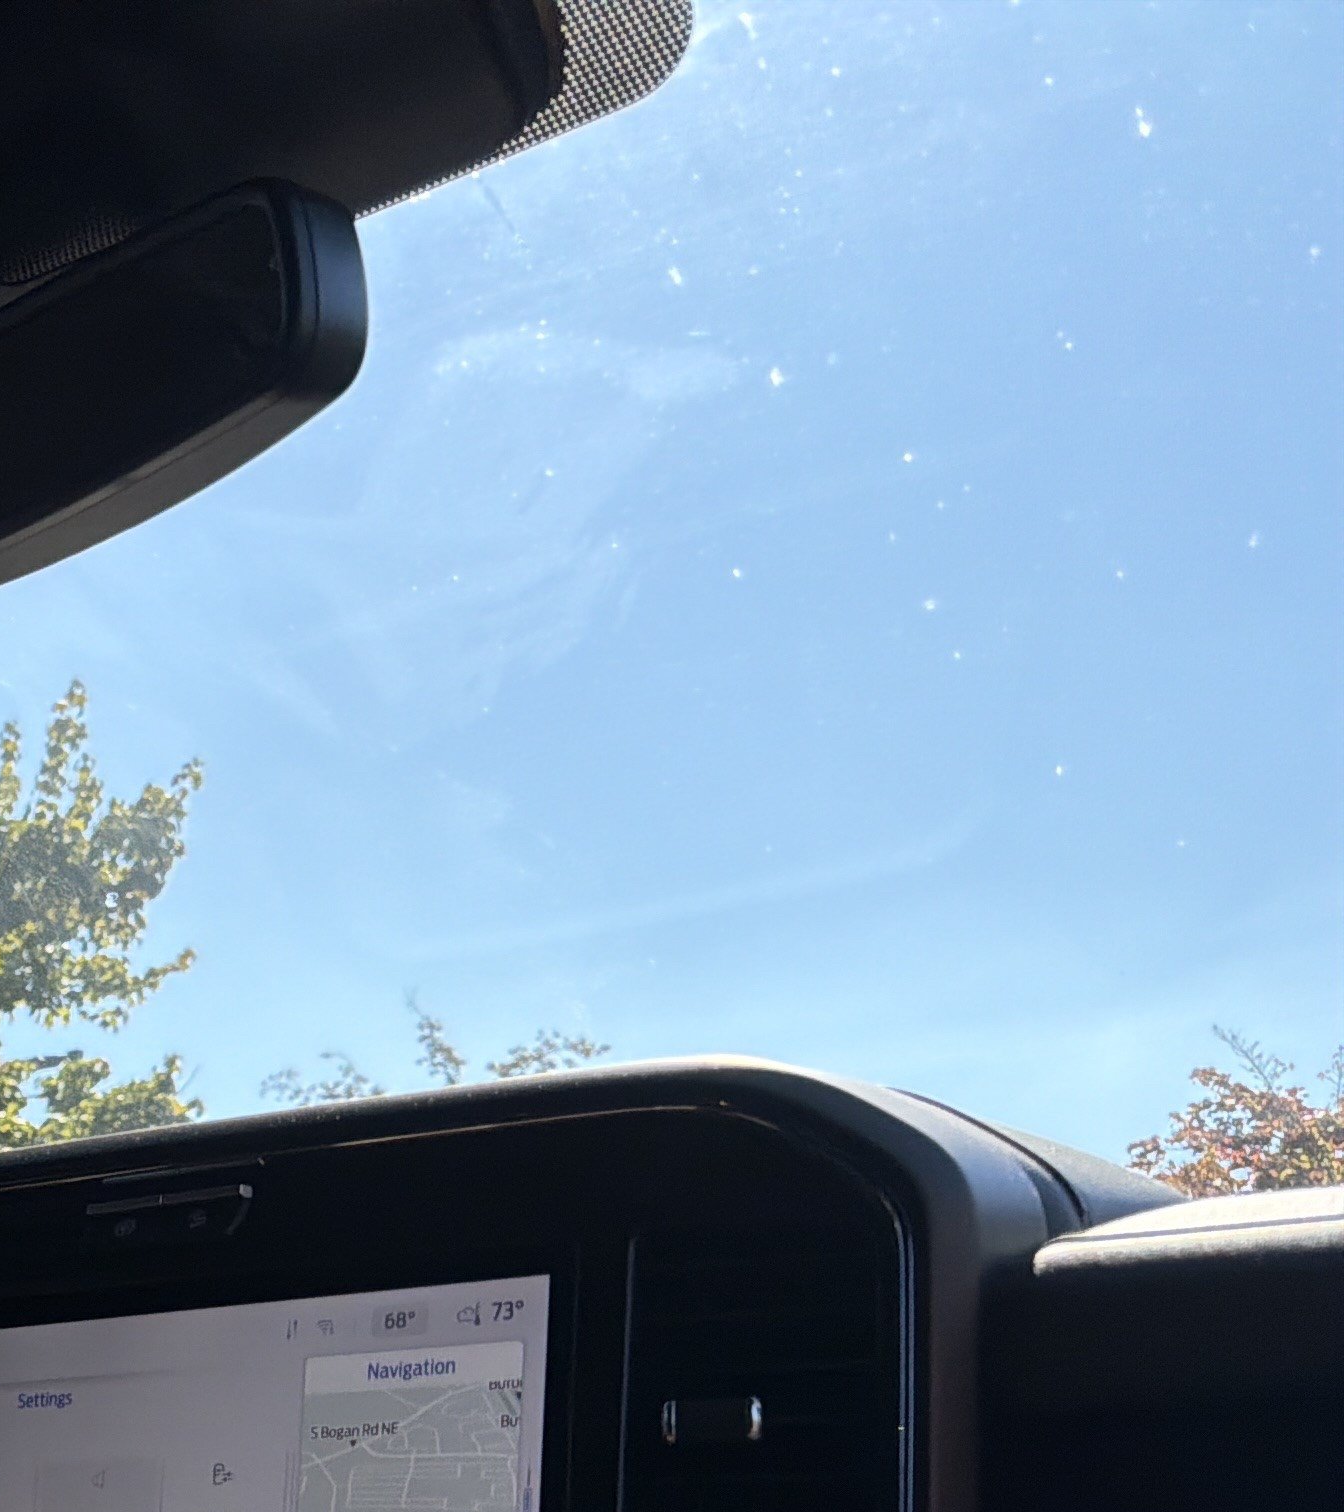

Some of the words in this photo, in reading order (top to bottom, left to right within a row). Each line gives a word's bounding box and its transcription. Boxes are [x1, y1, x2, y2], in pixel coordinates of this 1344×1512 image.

[367, 1359, 456, 1380] Navigation
[17, 1392, 73, 1409] Settings
[311, 1427, 318, 1438] S
[321, 1425, 360, 1440] Bogan
[362, 1423, 379, 1436] Rd
[381, 1421, 400, 1435] NE
